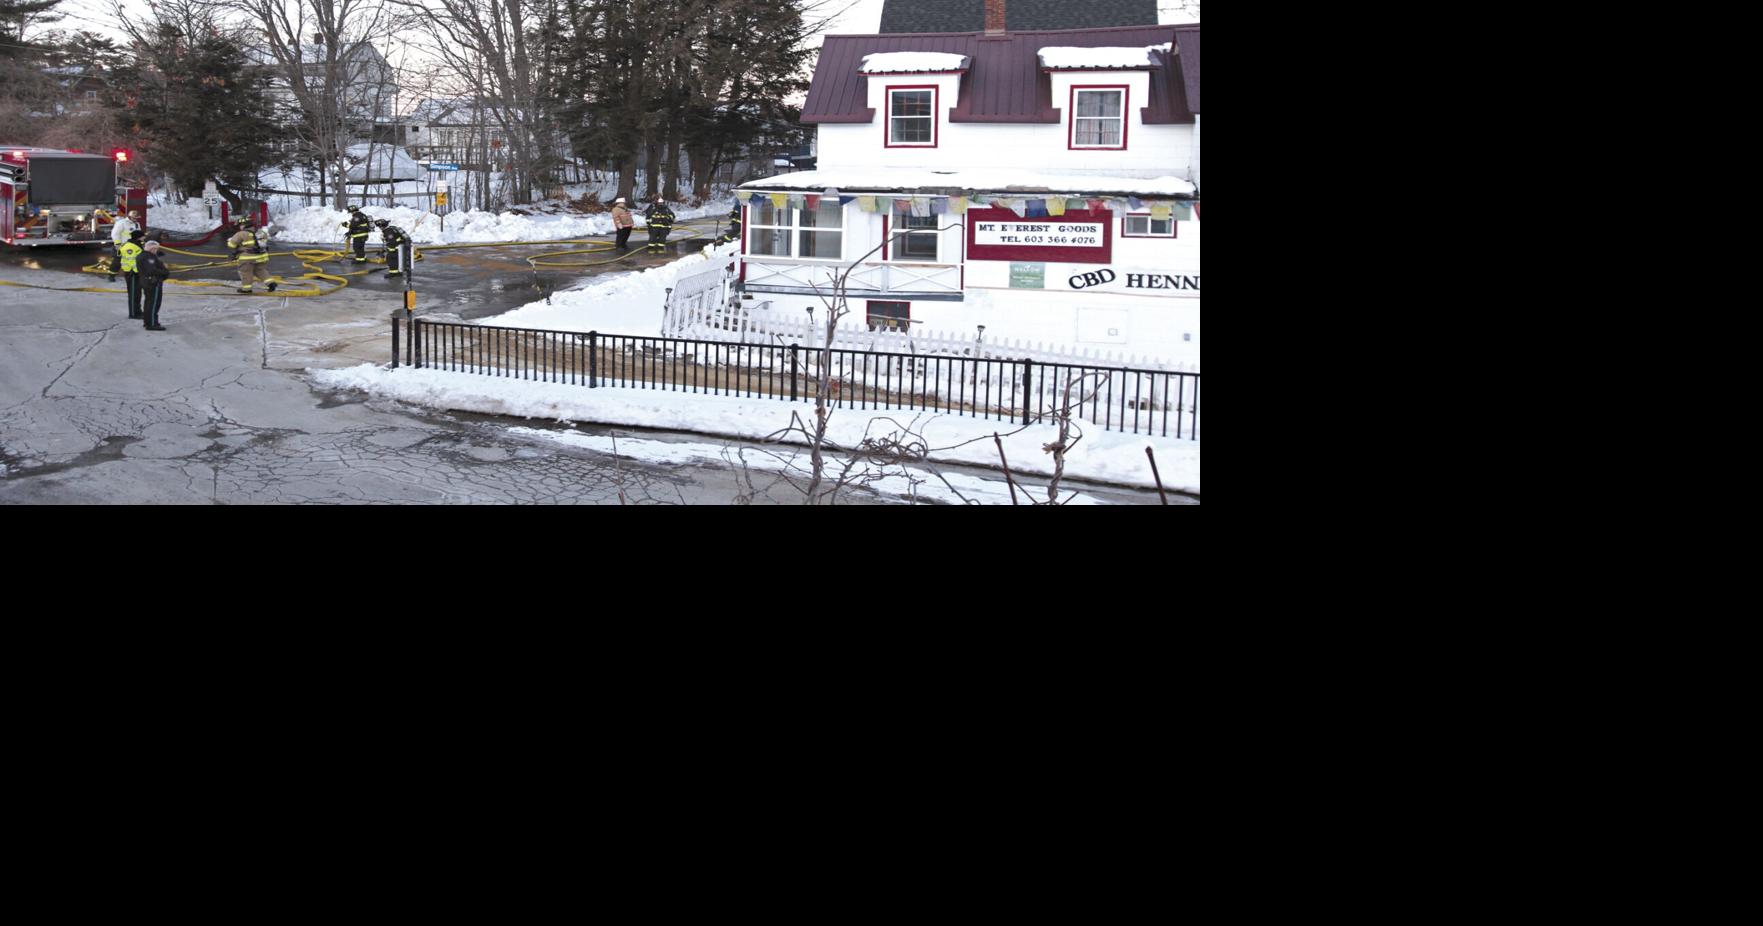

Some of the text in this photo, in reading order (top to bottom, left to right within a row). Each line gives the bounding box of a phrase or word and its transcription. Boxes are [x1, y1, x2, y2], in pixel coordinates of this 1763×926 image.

[1058, 225, 1097, 233] GOODS
[1048, 236, 1067, 244] 366
[1068, 268, 1200, 290] CBD HENN
